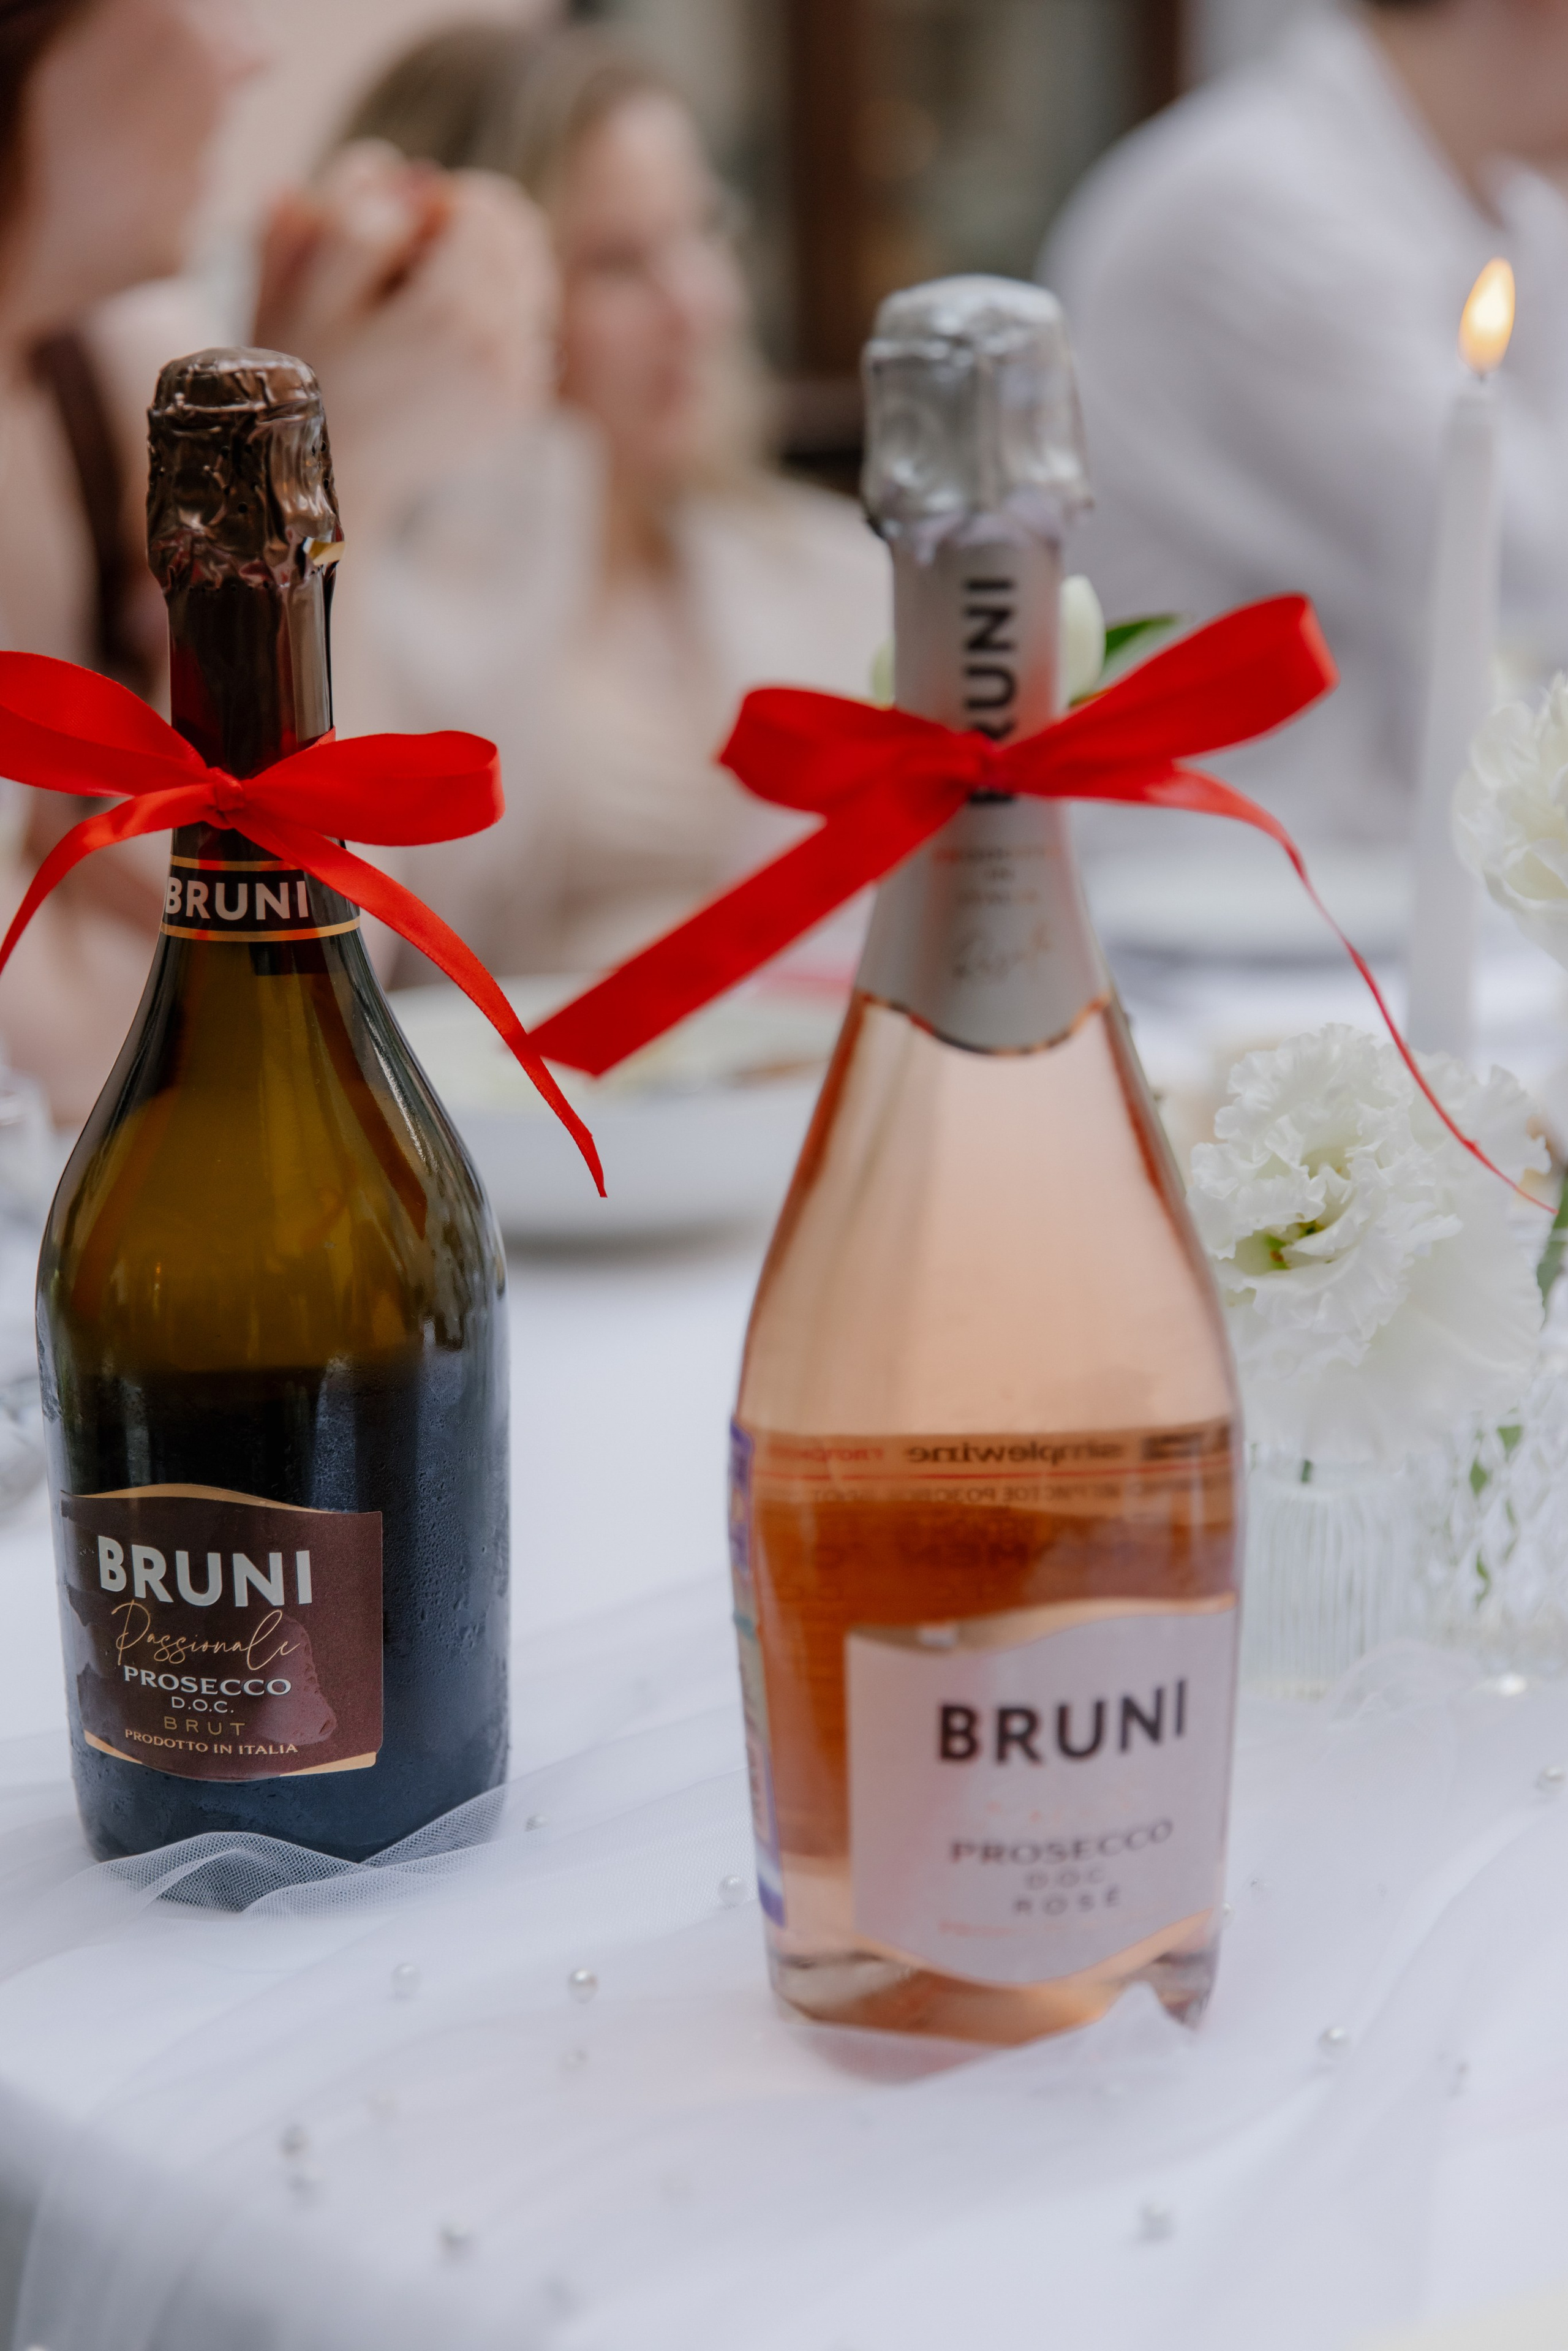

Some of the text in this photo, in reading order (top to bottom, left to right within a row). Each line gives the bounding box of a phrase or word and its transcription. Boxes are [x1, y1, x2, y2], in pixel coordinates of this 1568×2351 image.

[963, 577, 1017, 805] UNI
[165, 876, 309, 921] BRUNI
[98, 1535, 312, 1607] BRUNI
[111, 1599, 300, 1670] Passionale
[124, 1665, 292, 1696] PROSECCO
[164, 1716, 245, 1736] BRUT
[172, 1696, 234, 1713] D.O.C.
[938, 1677, 1187, 1766] BRUNI
[125, 1729, 298, 1755] PRODOTTO IN ITALIA
[951, 1817, 1173, 1865] PROSECCO
